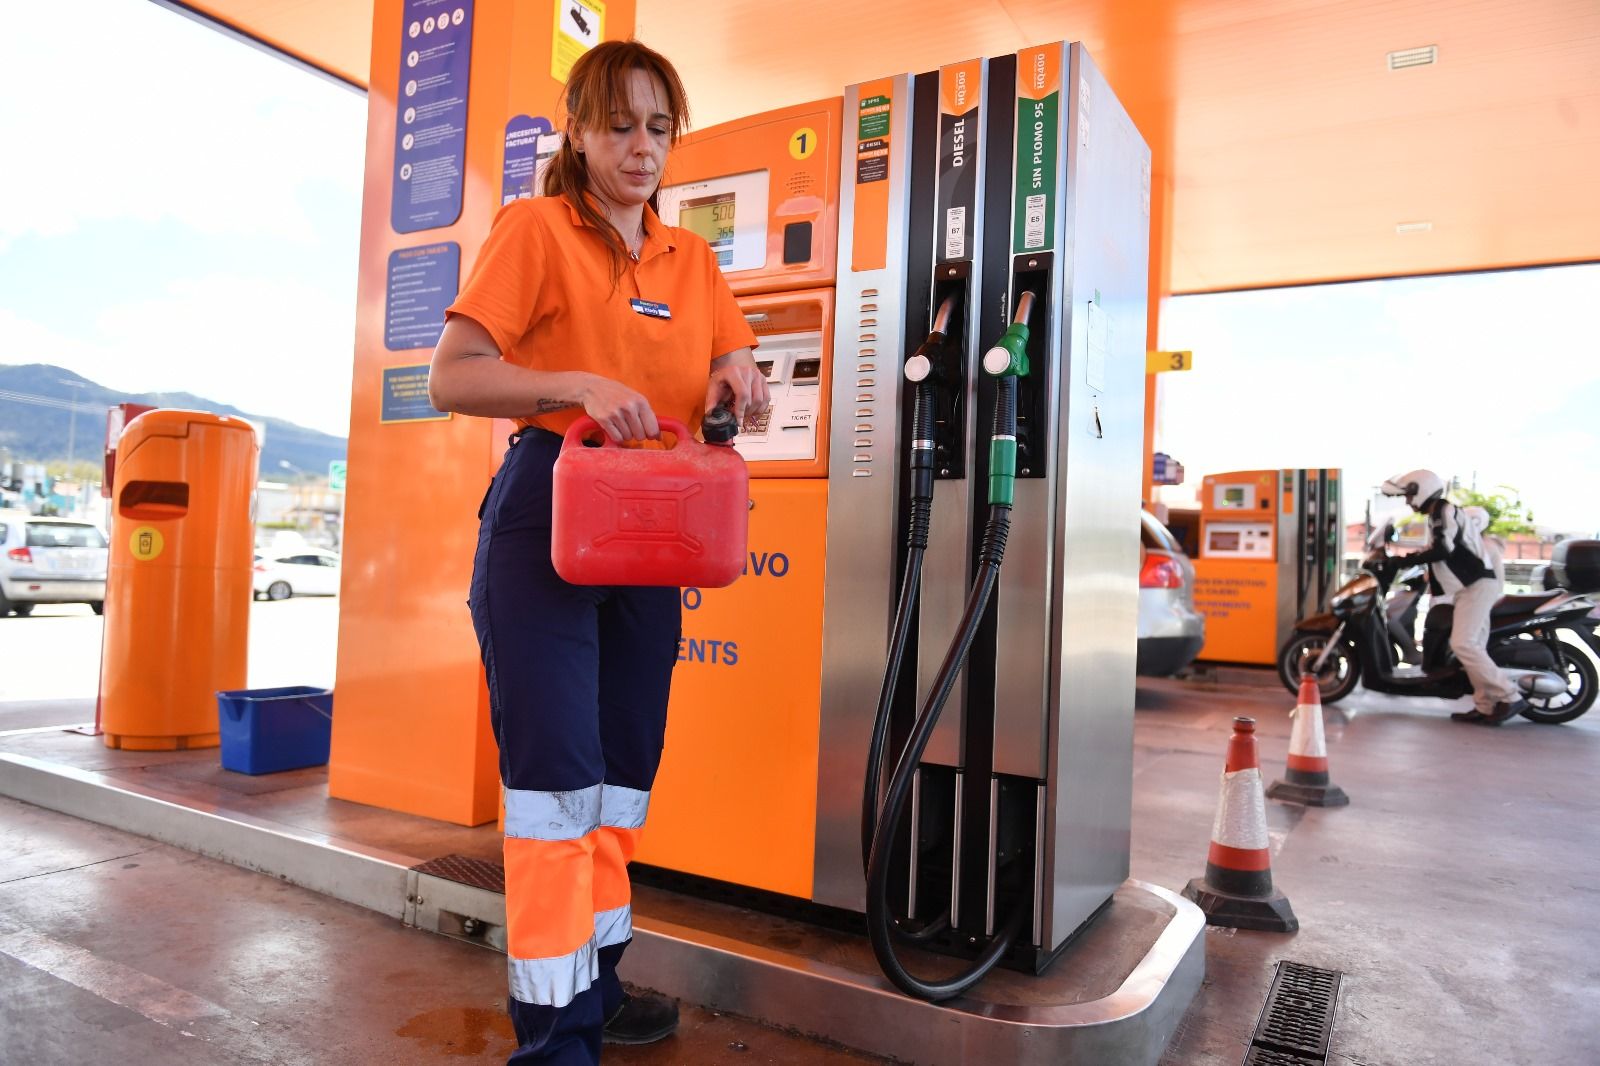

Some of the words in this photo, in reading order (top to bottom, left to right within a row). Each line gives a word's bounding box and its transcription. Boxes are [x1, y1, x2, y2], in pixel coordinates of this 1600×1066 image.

[1037, 53, 1046, 89] HQ400
[957, 71, 966, 105] HQ300
[1034, 102, 1044, 118] 95
[796, 133, 807, 154] 1
[952, 118, 965, 168] DIESEL
[1034, 121, 1044, 164] PLOMO
[1033, 167, 1042, 189] SIN
[1031, 215, 1040, 223] E5
[1171, 352, 1184, 370] 3
